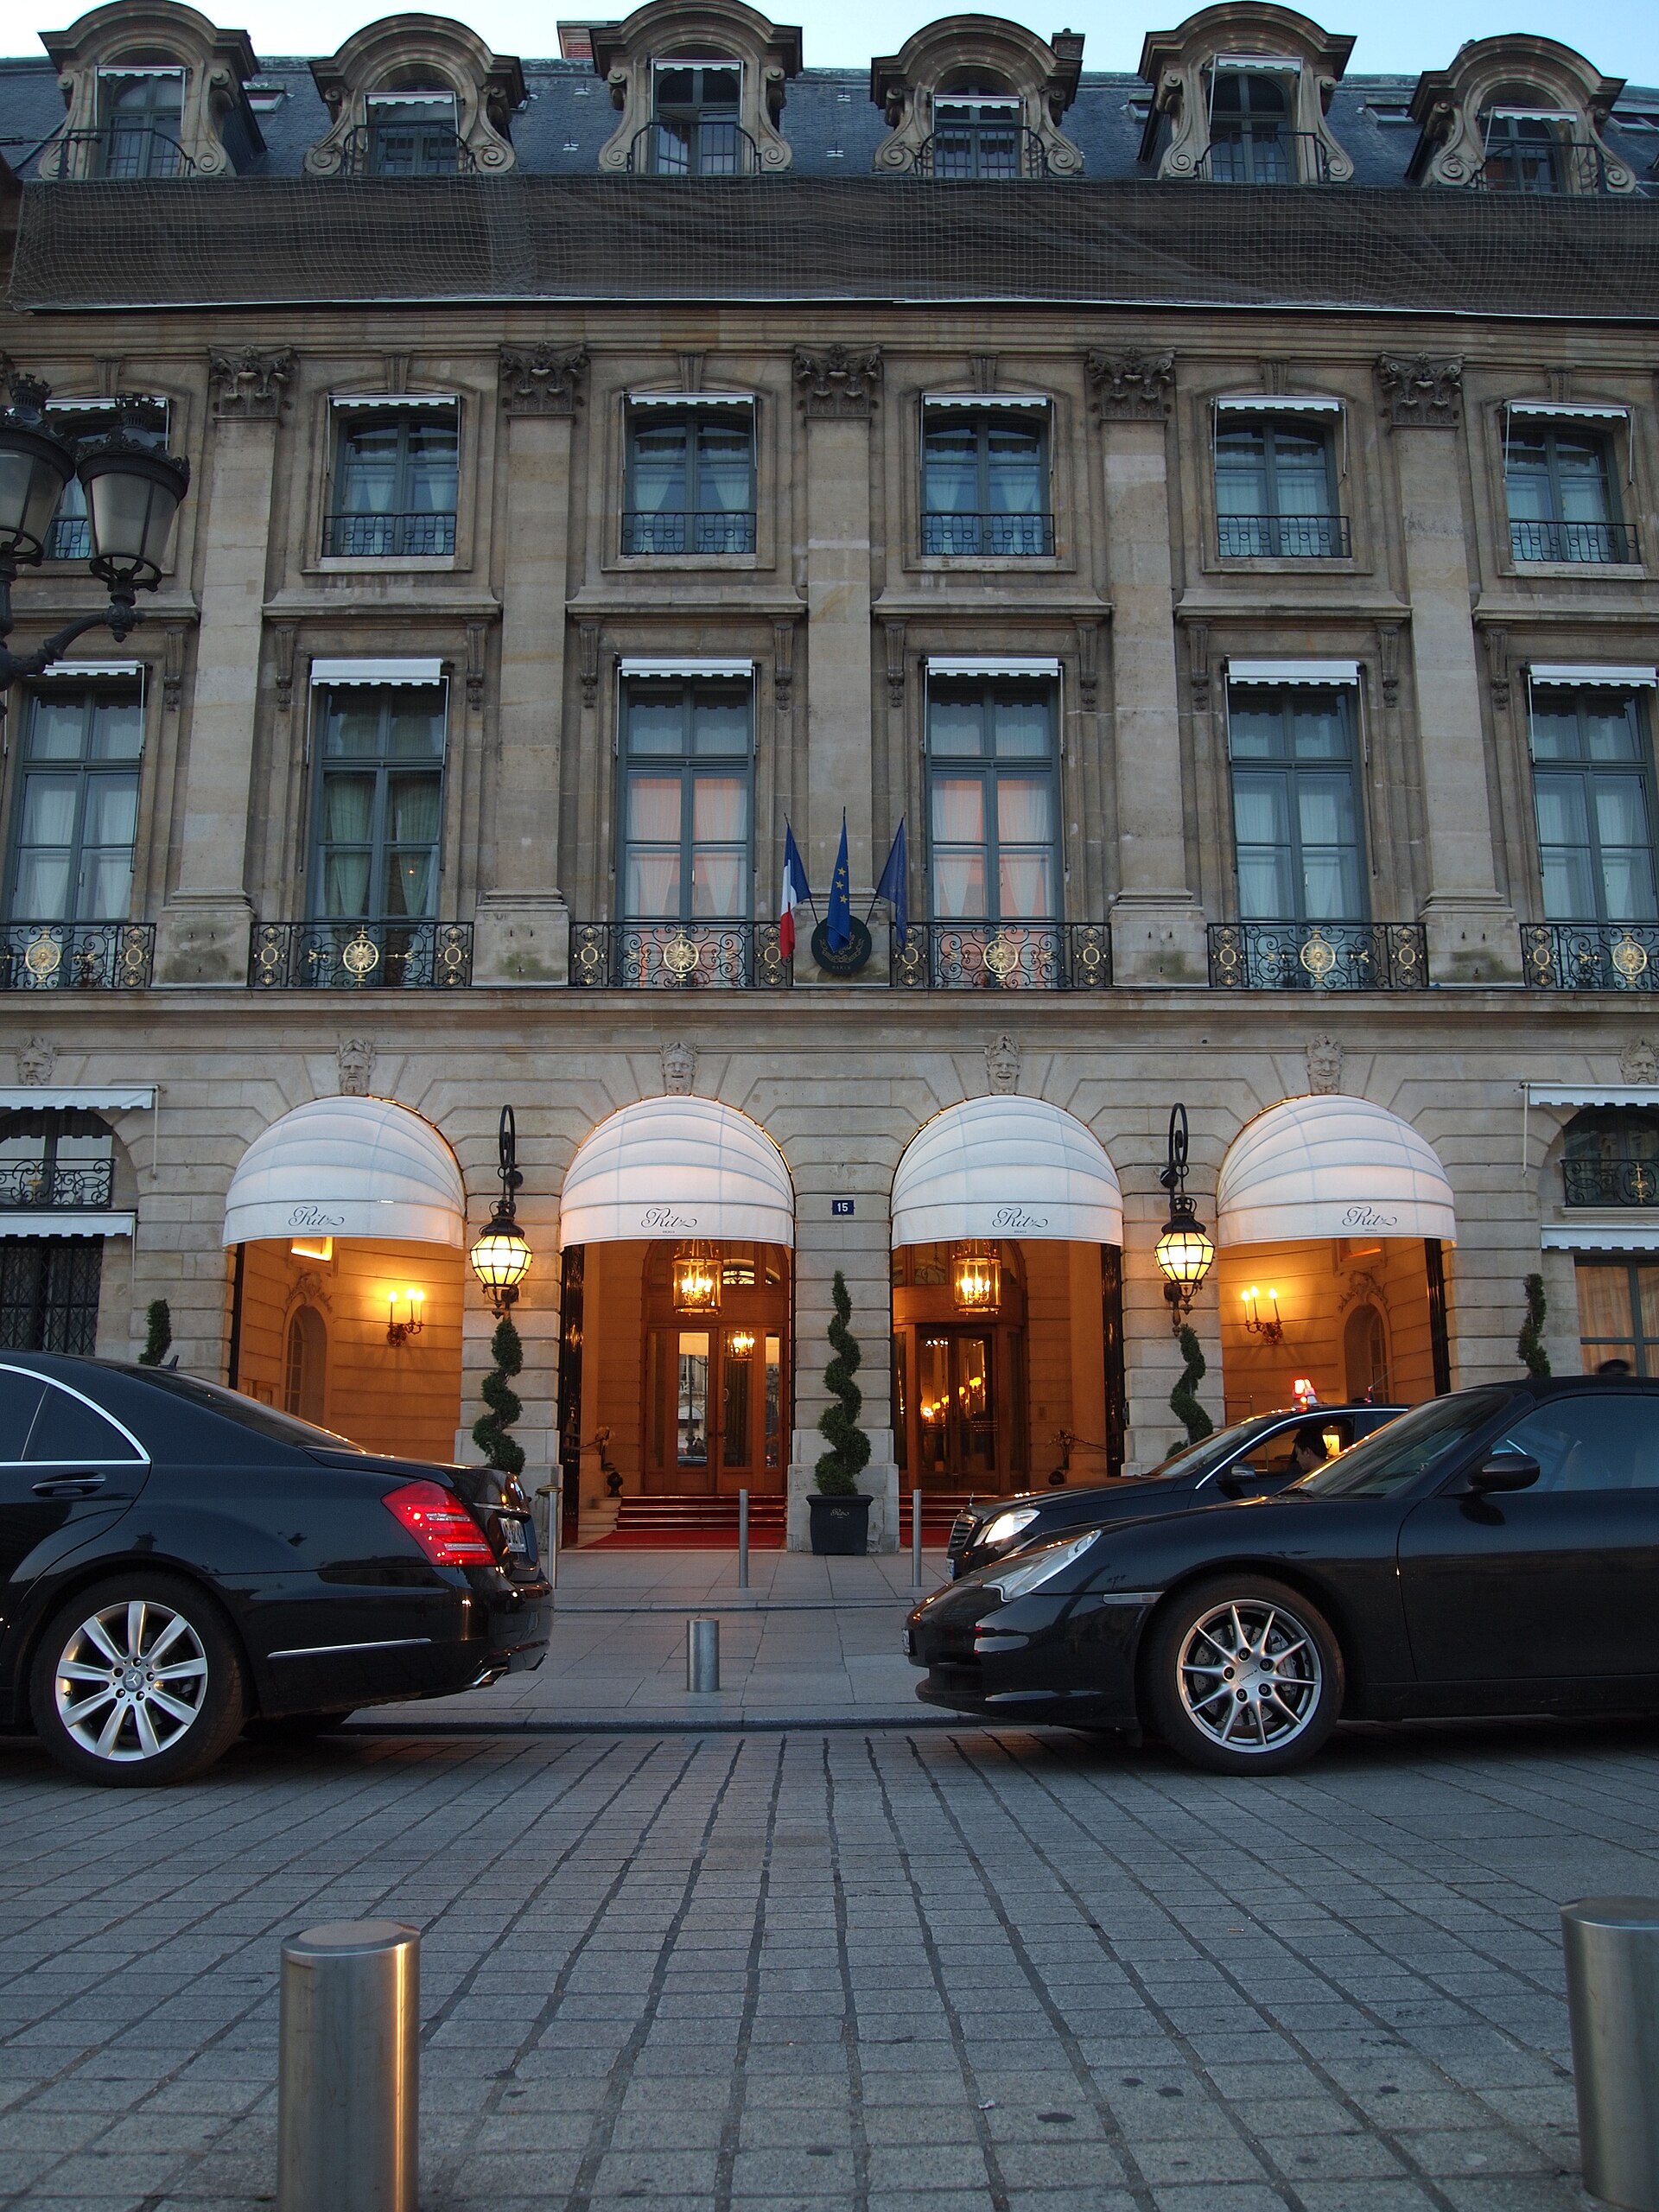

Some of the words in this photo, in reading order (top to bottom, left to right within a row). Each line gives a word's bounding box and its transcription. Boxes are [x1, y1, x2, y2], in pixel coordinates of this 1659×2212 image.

[288, 1205, 345, 1226] Ritz
[640, 1207, 697, 1228] Ritz
[837, 1202, 849, 1212] 15
[992, 1207, 1048, 1228] Ritz
[1342, 1205, 1398, 1226] Ritz
